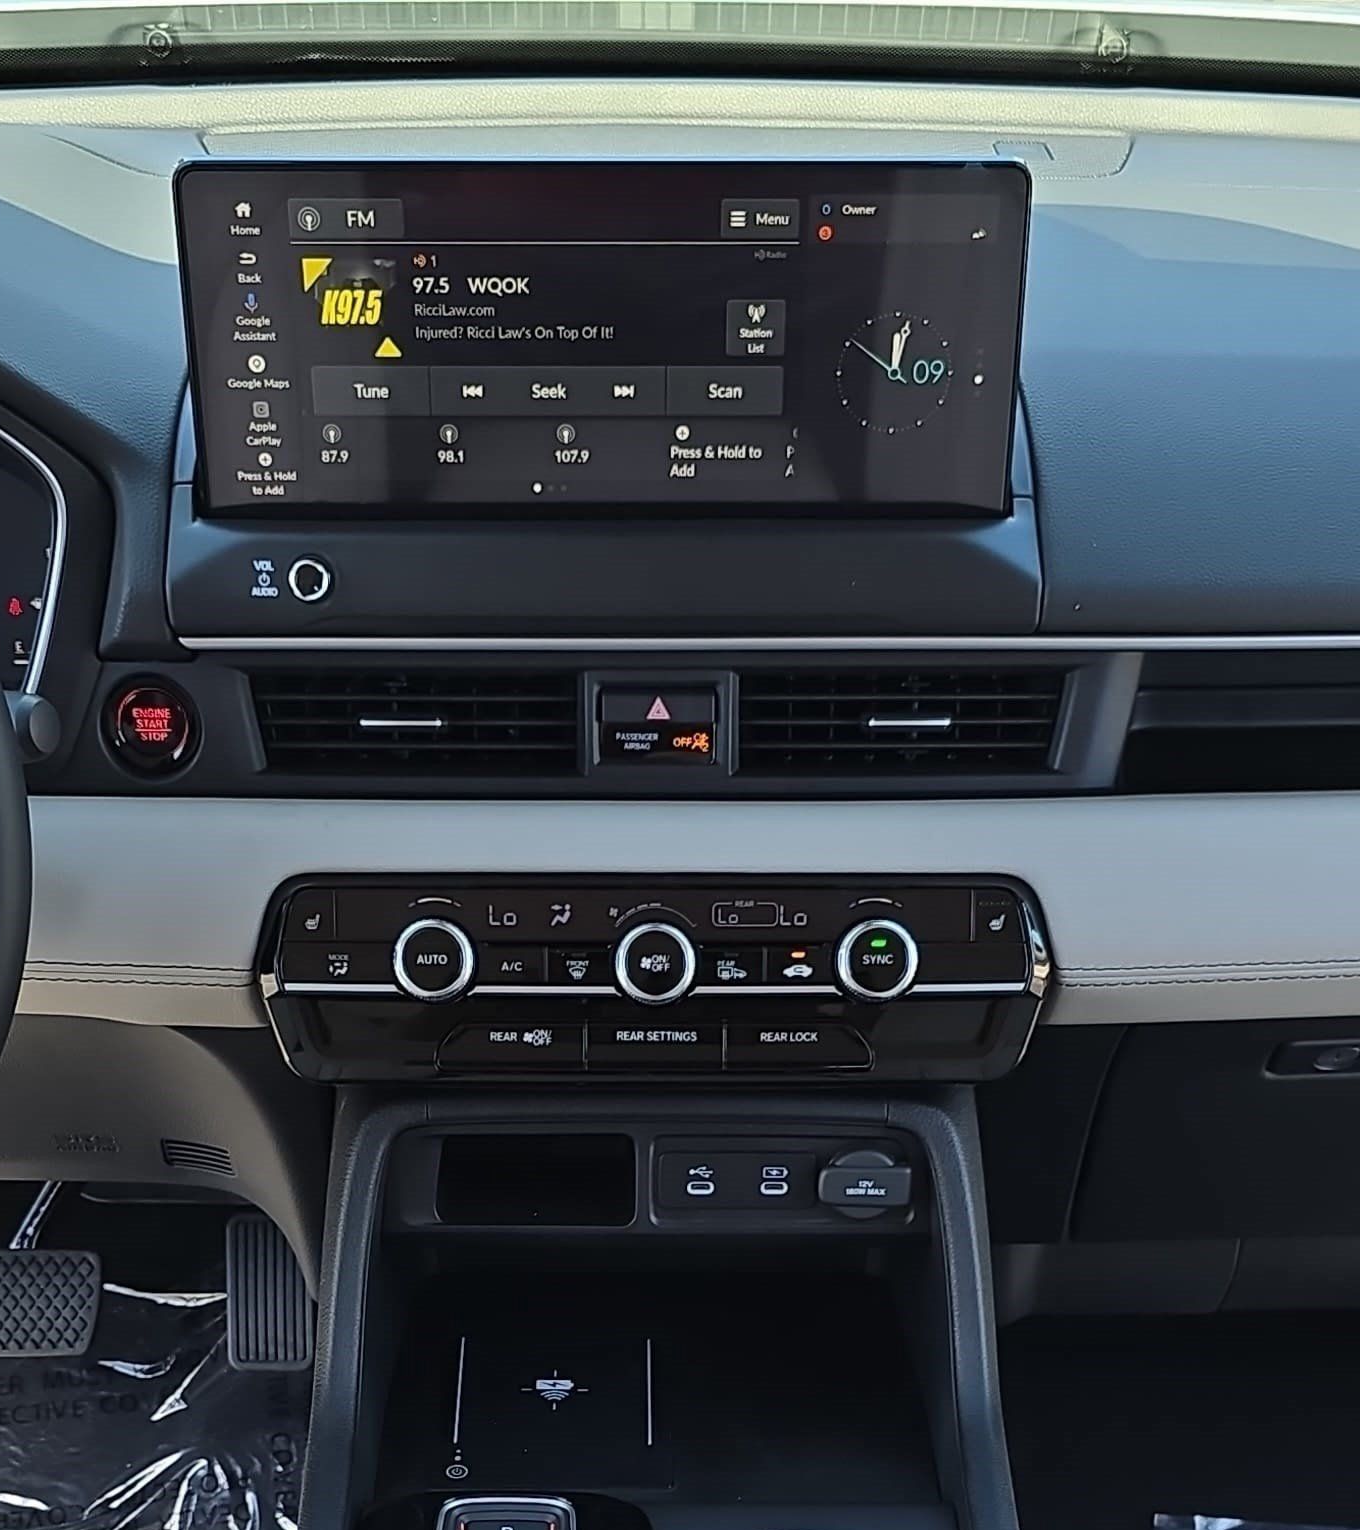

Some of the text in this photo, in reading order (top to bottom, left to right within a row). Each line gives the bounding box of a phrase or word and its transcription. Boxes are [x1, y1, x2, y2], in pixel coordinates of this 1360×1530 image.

[841, 204, 877, 216] Owner
[346, 211, 376, 228] FM
[755, 213, 791, 226] Menu
[230, 225, 262, 236] Home
[237, 273, 262, 284] Back
[412, 278, 530, 294] 97.5 WQOK
[320, 289, 383, 326] K97.5
[414, 304, 495, 317] RicciLaw.com
[236, 316, 271, 328] Google
[233, 331, 277, 342] Assistant
[415, 326, 615, 341] Injured? Ricci Law's On Top Of It!
[739, 328, 773, 340] Station
[747, 343, 765, 354] List
[912, 360, 945, 385] 09
[227, 377, 290, 390] Google Maps
[353, 384, 389, 399] Tune
[531, 384, 567, 398] Seek
[708, 384, 743, 398] Scan
[249, 421, 277, 433] Apple
[246, 436, 282, 448] CarPlay
[321, 451, 349, 463] 87.9
[437, 451, 464, 463] 98.1
[554, 451, 590, 463] 107.9
[670, 446, 762, 459] Press & Hold to
[237, 471, 263, 482] Press
[273, 471, 297, 482] Hold
[670, 464, 695, 478] Add
[252, 485, 285, 497] to Add
[253, 560, 274, 571] VOL
[251, 587, 278, 597] AUDIO
[132, 708, 172, 719] ENGINE
[136, 719, 169, 730] START
[140, 732, 168, 742] STOP
[616, 732, 659, 741] PASSENGER
[673, 738, 692, 747] OFF
[624, 742, 651, 751] AIRBAG
[488, 905, 517, 926] Lo
[717, 908, 739, 925] Lo
[779, 905, 808, 927] Lo
[416, 954, 448, 965] AUTO
[566, 960, 589, 968] FRONT
[862, 954, 894, 966] SYNC
[501, 961, 523, 972] A/C
[651, 963, 671, 972] OFF
[490, 1031, 517, 1042] REAR
[533, 1037, 552, 1047] OFF
[616, 1031, 697, 1042] REAR SETTINGS
[760, 1031, 818, 1042] REAR LOCK
